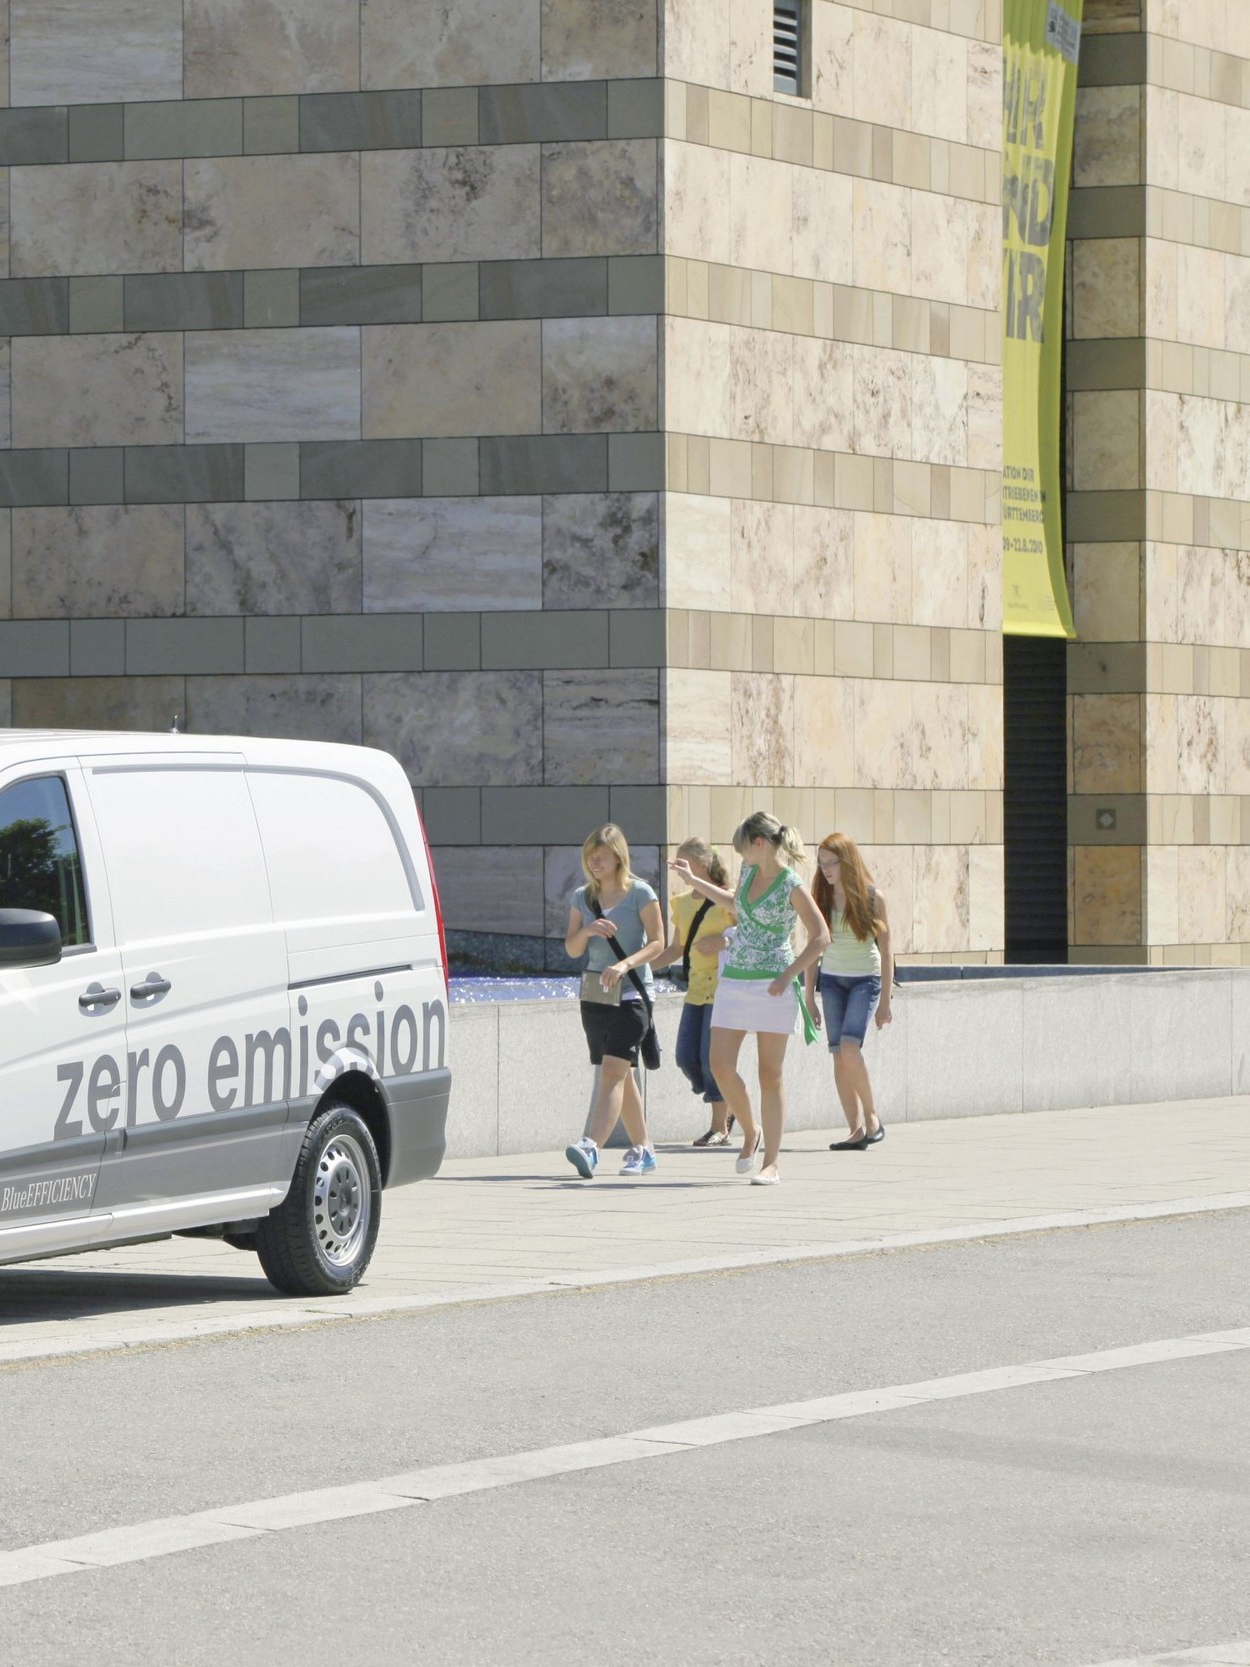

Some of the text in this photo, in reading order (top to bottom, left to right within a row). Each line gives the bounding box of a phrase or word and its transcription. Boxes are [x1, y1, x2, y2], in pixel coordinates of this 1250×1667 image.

[1002, 249, 1045, 343] IR
[53, 980, 446, 1141] zero emission
[0, 1173, 97, 1212] BlueEFFICIENCY
